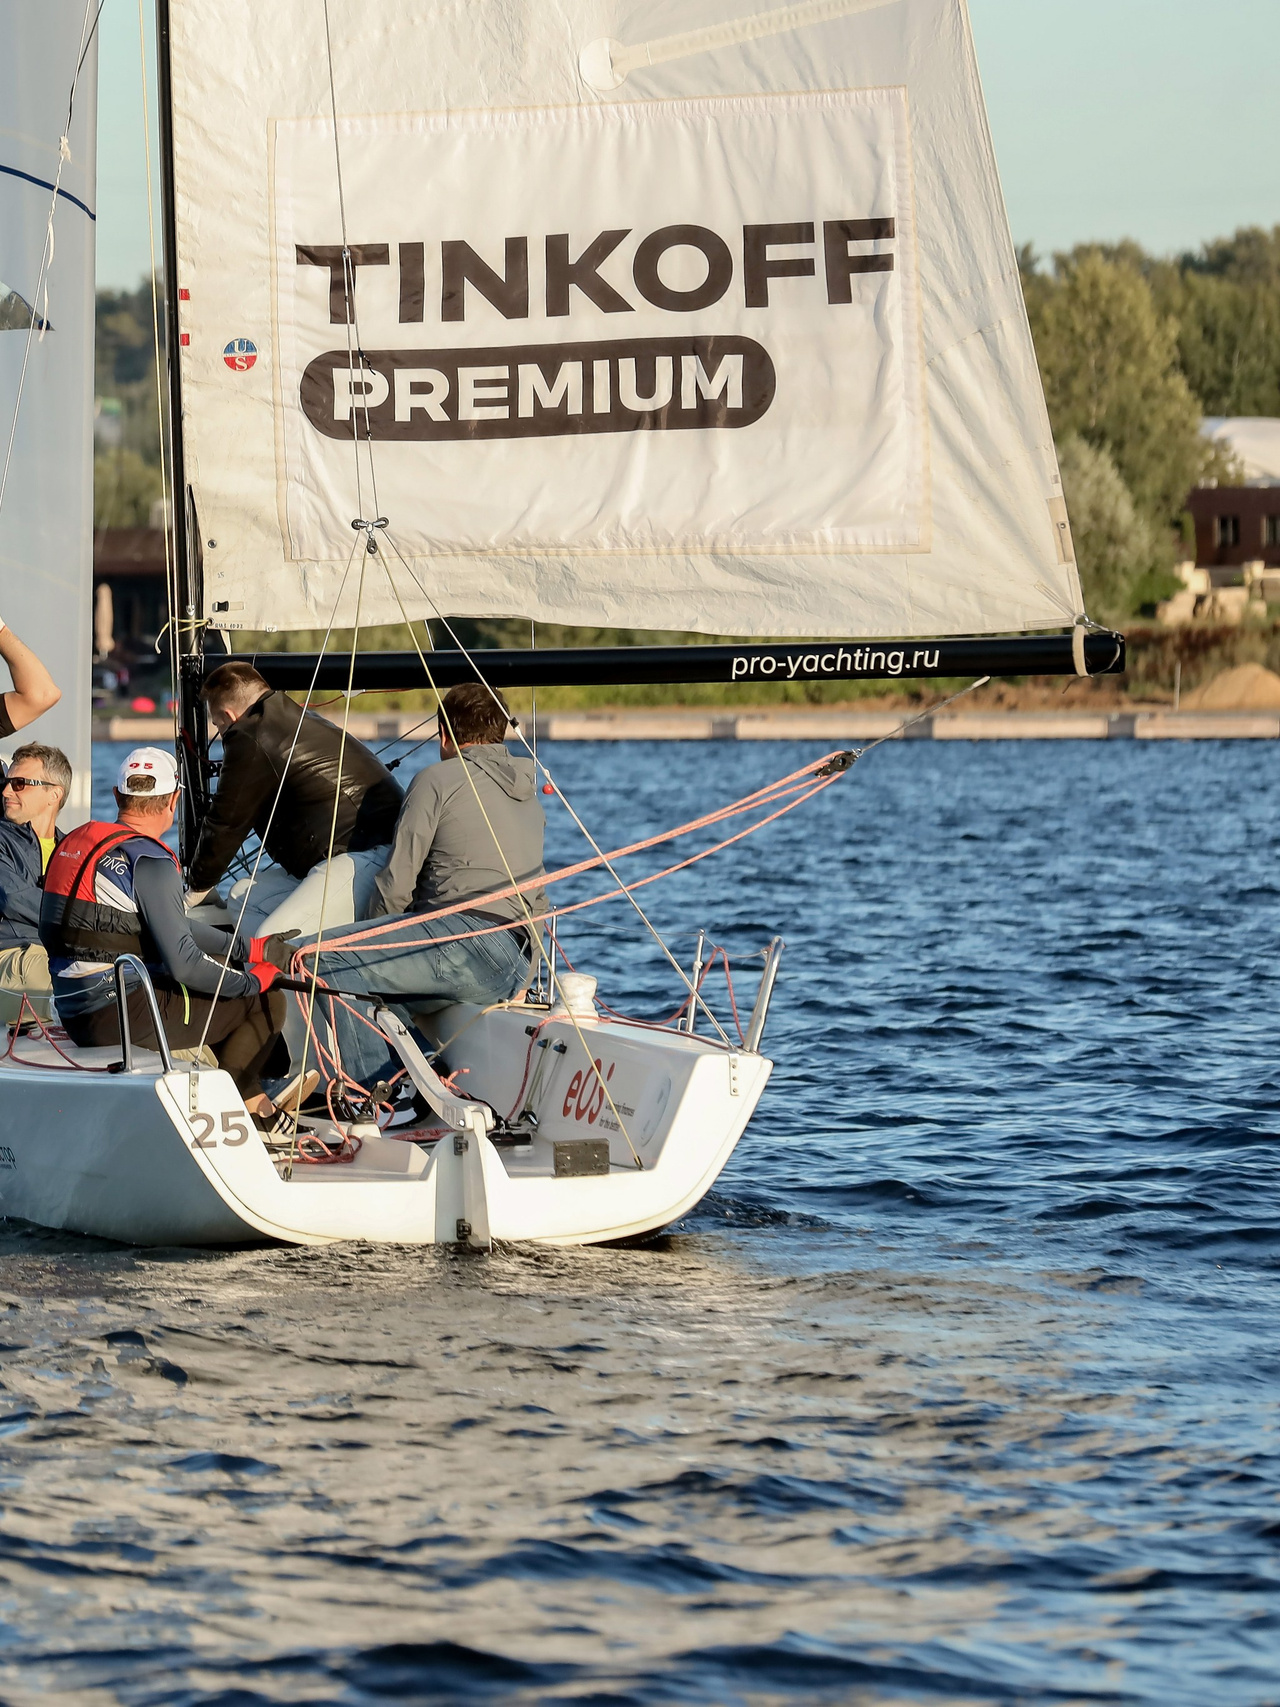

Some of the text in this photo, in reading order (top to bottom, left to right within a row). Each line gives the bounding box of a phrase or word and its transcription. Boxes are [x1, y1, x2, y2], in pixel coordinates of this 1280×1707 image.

[295, 217, 895, 324] TINKOFF
[332, 354, 743, 422] PREMIUM
[731, 647, 941, 680] pro-yachting.ru
[129, 762, 154, 770] 95
[188, 1110, 249, 1149] 25
